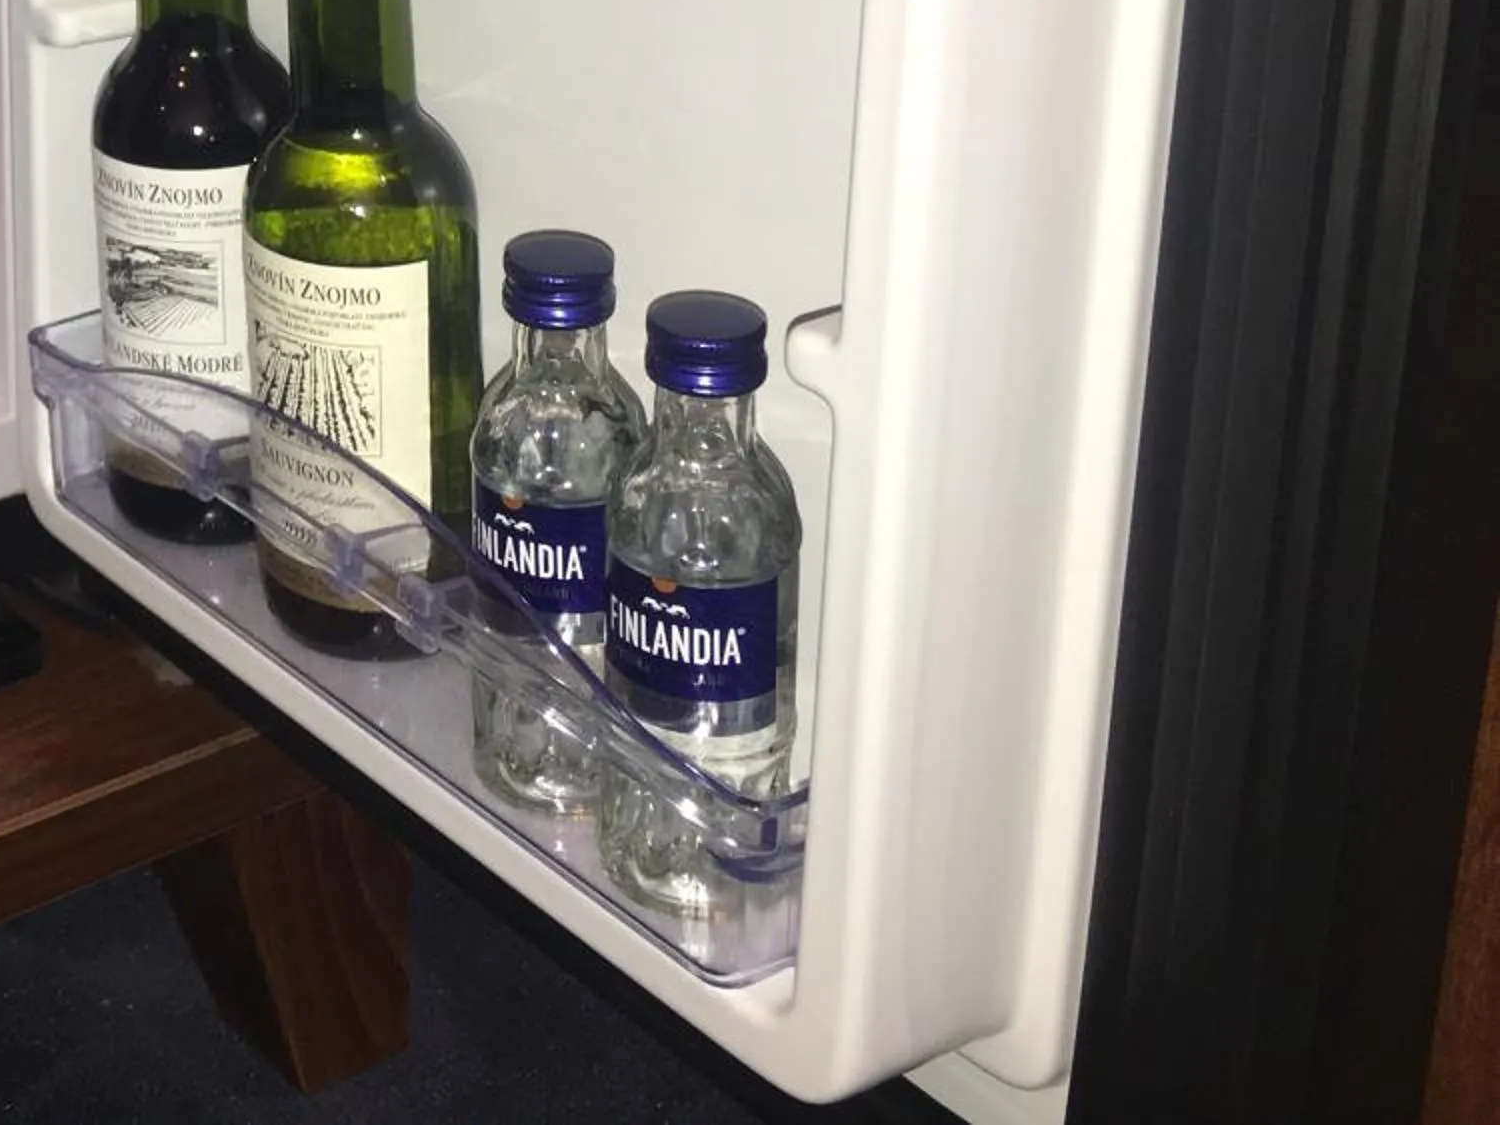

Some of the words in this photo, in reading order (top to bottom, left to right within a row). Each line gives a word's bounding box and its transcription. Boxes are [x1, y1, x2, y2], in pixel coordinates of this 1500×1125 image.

[149, 183, 224, 209] ZNOJMO
[299, 277, 382, 310] ZNOJMO
[177, 351, 244, 374] MODRÉ
[610, 594, 742, 666] FINLANDIA
